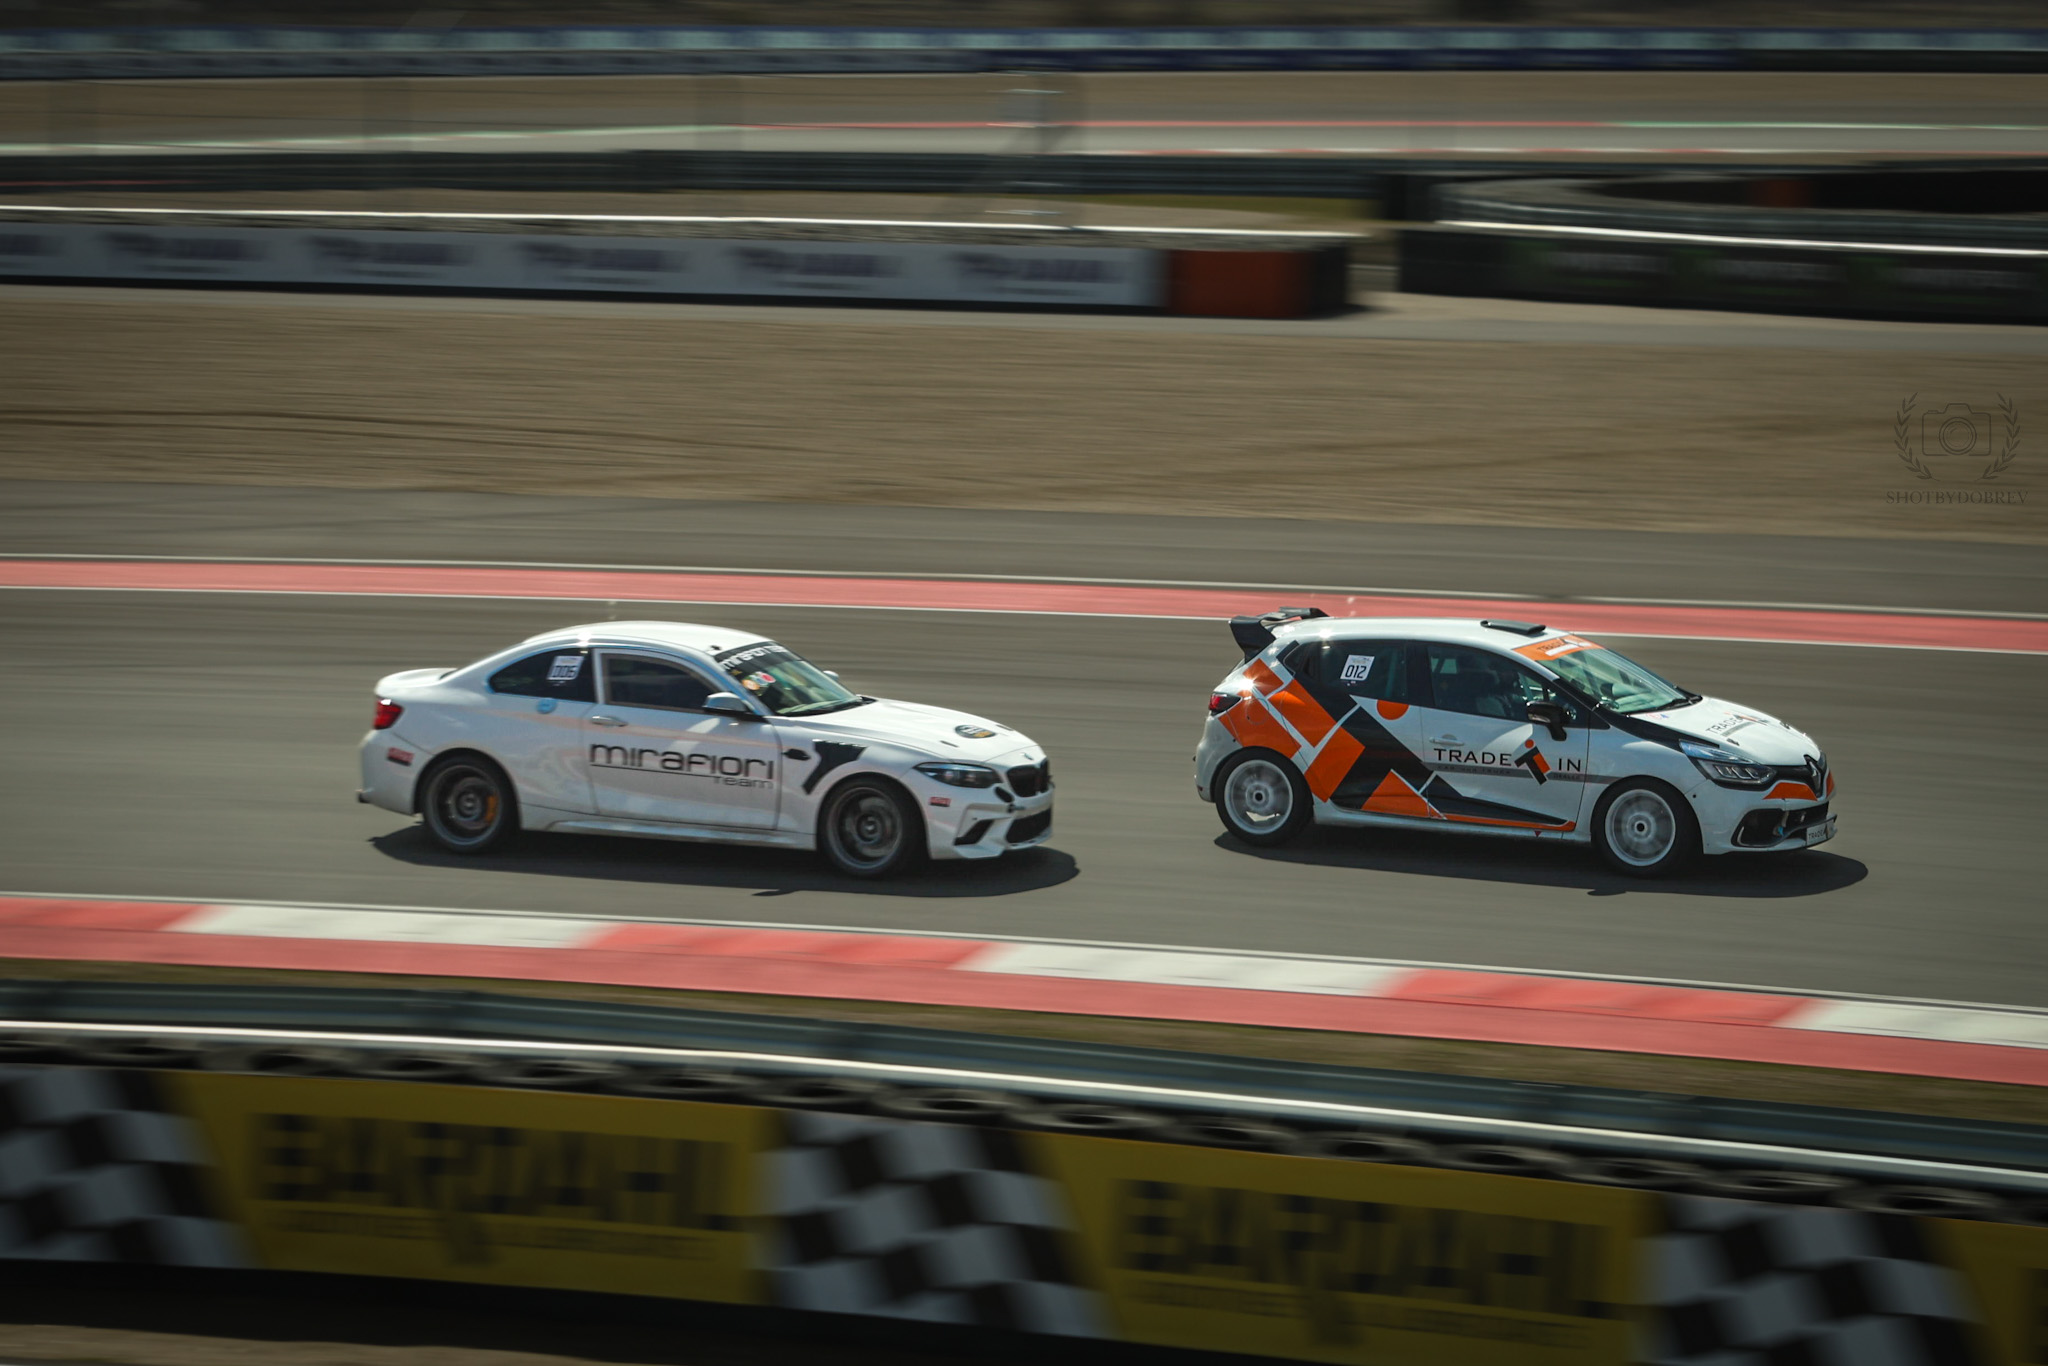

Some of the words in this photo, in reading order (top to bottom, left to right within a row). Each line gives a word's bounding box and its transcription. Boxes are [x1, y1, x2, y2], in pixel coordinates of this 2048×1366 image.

[1345, 664, 1367, 679] 012
[1434, 748, 1512, 766] TRADE
[1558, 758, 1581, 772] IN
